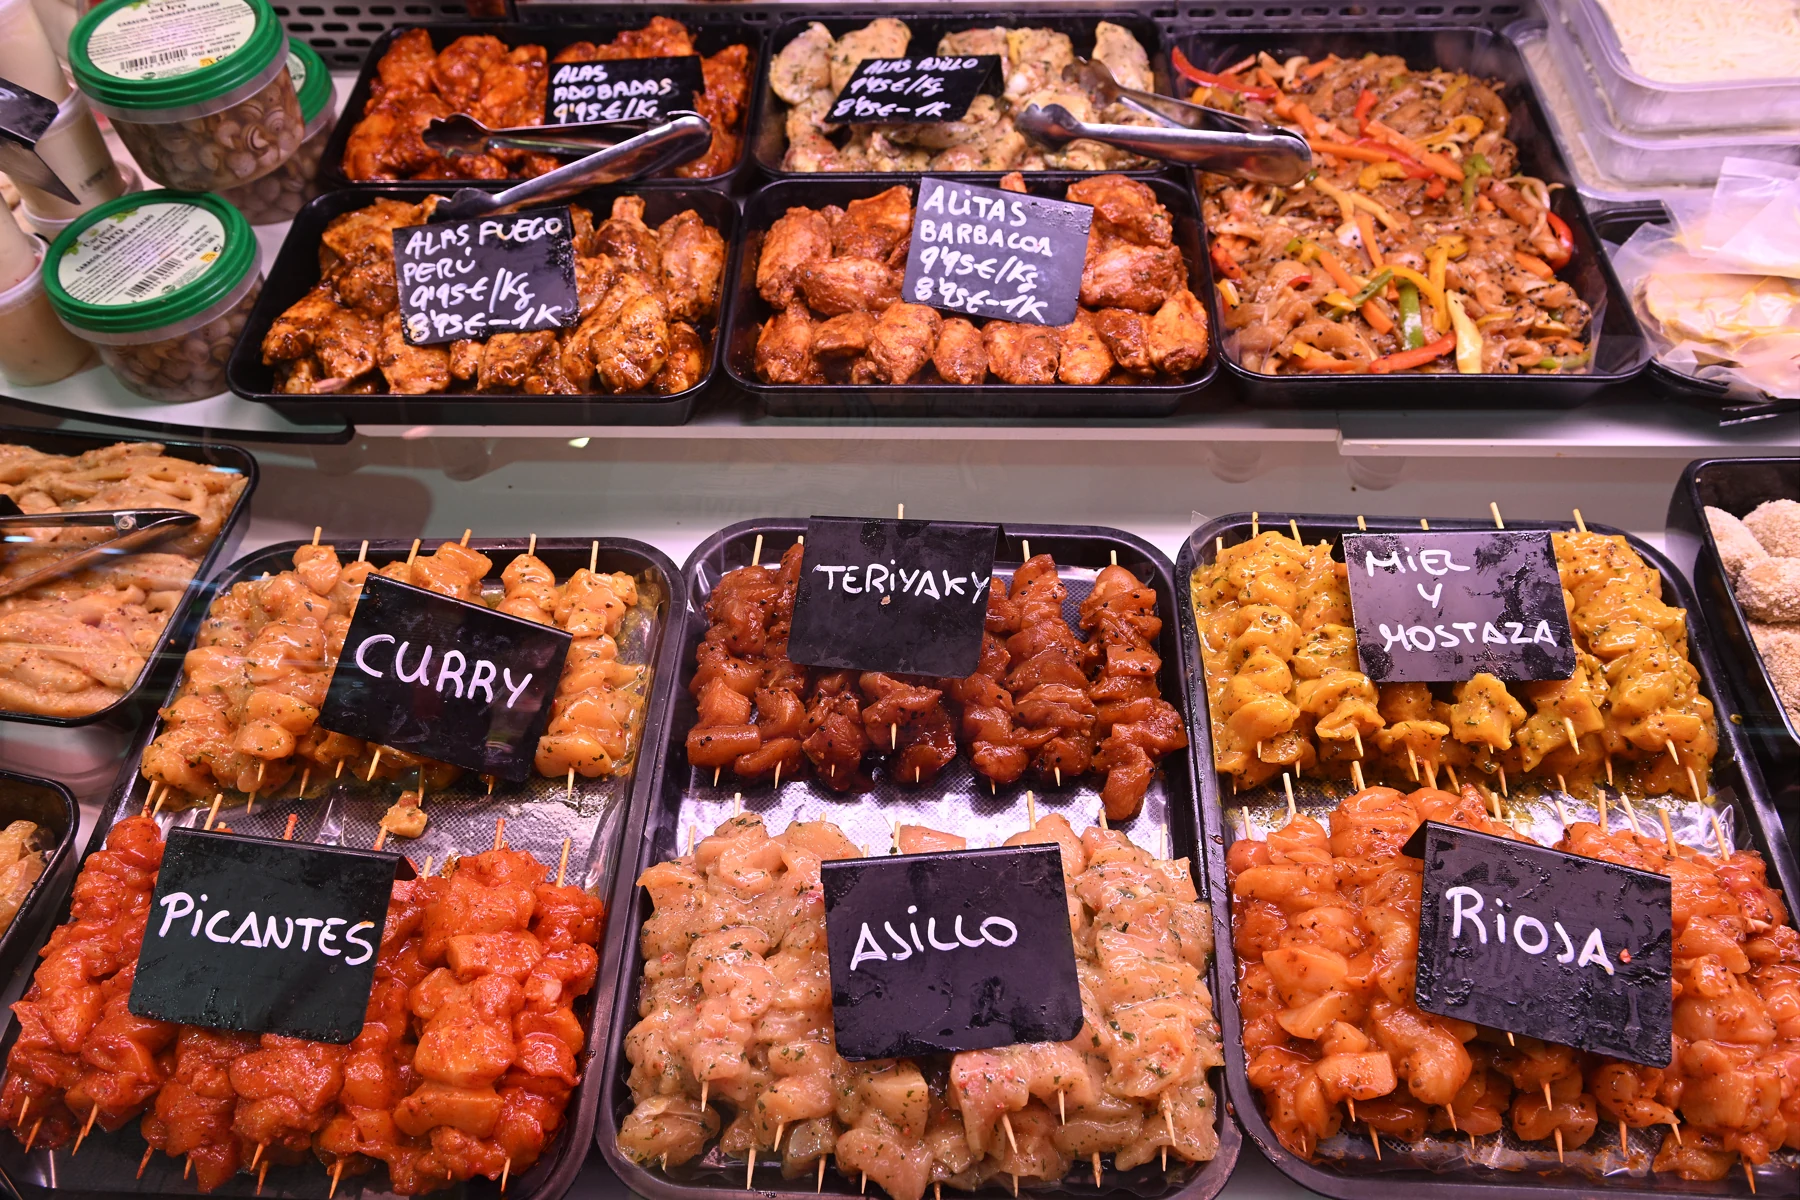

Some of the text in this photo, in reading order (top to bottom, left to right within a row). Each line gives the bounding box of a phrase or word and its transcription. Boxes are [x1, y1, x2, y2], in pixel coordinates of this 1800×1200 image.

[552, 65, 608, 84] ALAS
[863, 60, 912, 75] ALAS
[553, 78, 672, 102] ADOBADAS
[100, 229, 124, 244] Oro
[405, 217, 562, 259] ALAS FUEGO
[920, 219, 1053, 257] BARBACOA
[1379, 620, 1557, 652] MOSTAZA
[355, 634, 533, 708] CURRY
